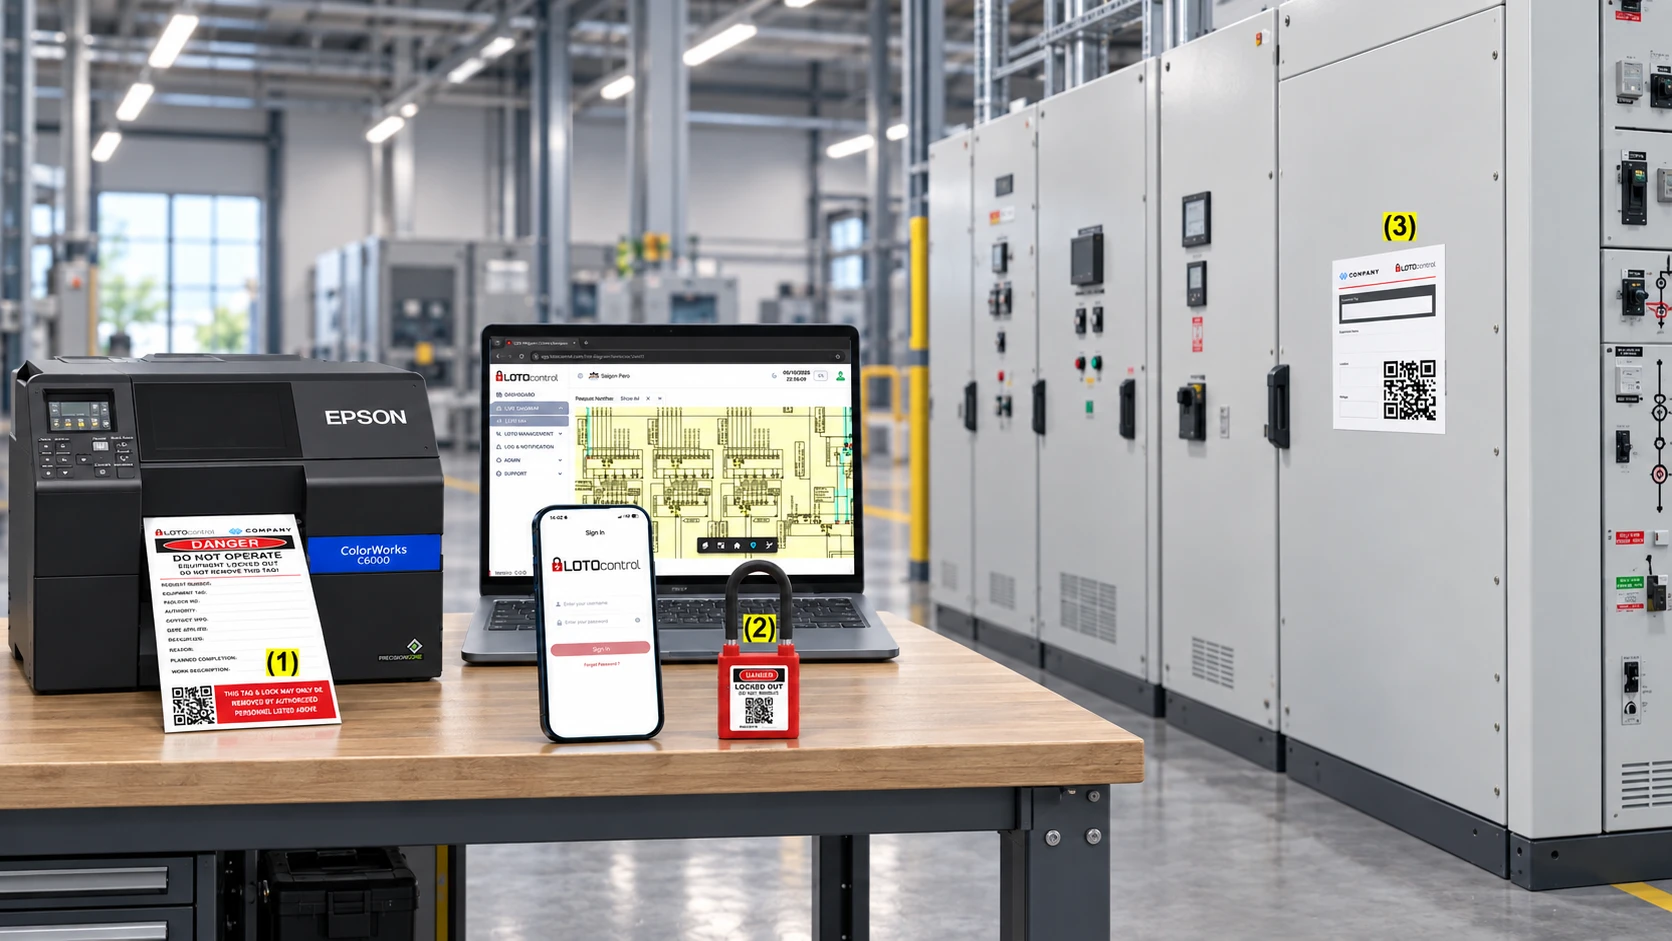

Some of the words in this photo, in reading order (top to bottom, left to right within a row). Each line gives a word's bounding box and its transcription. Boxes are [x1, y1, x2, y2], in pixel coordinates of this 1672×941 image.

[503, 373, 558, 382] LOTOcontrol
[324, 410, 408, 425] EPSON
[585, 529, 598, 537] Sign
[191, 539, 259, 549] DANGER
[340, 545, 407, 556] ColorWorks
[173, 554, 191, 562] DO
[195, 553, 221, 561] NOT
[224, 551, 282, 560] OPERATE
[357, 556, 390, 565] C6000
[564, 559, 641, 572] LOTOcontrol
